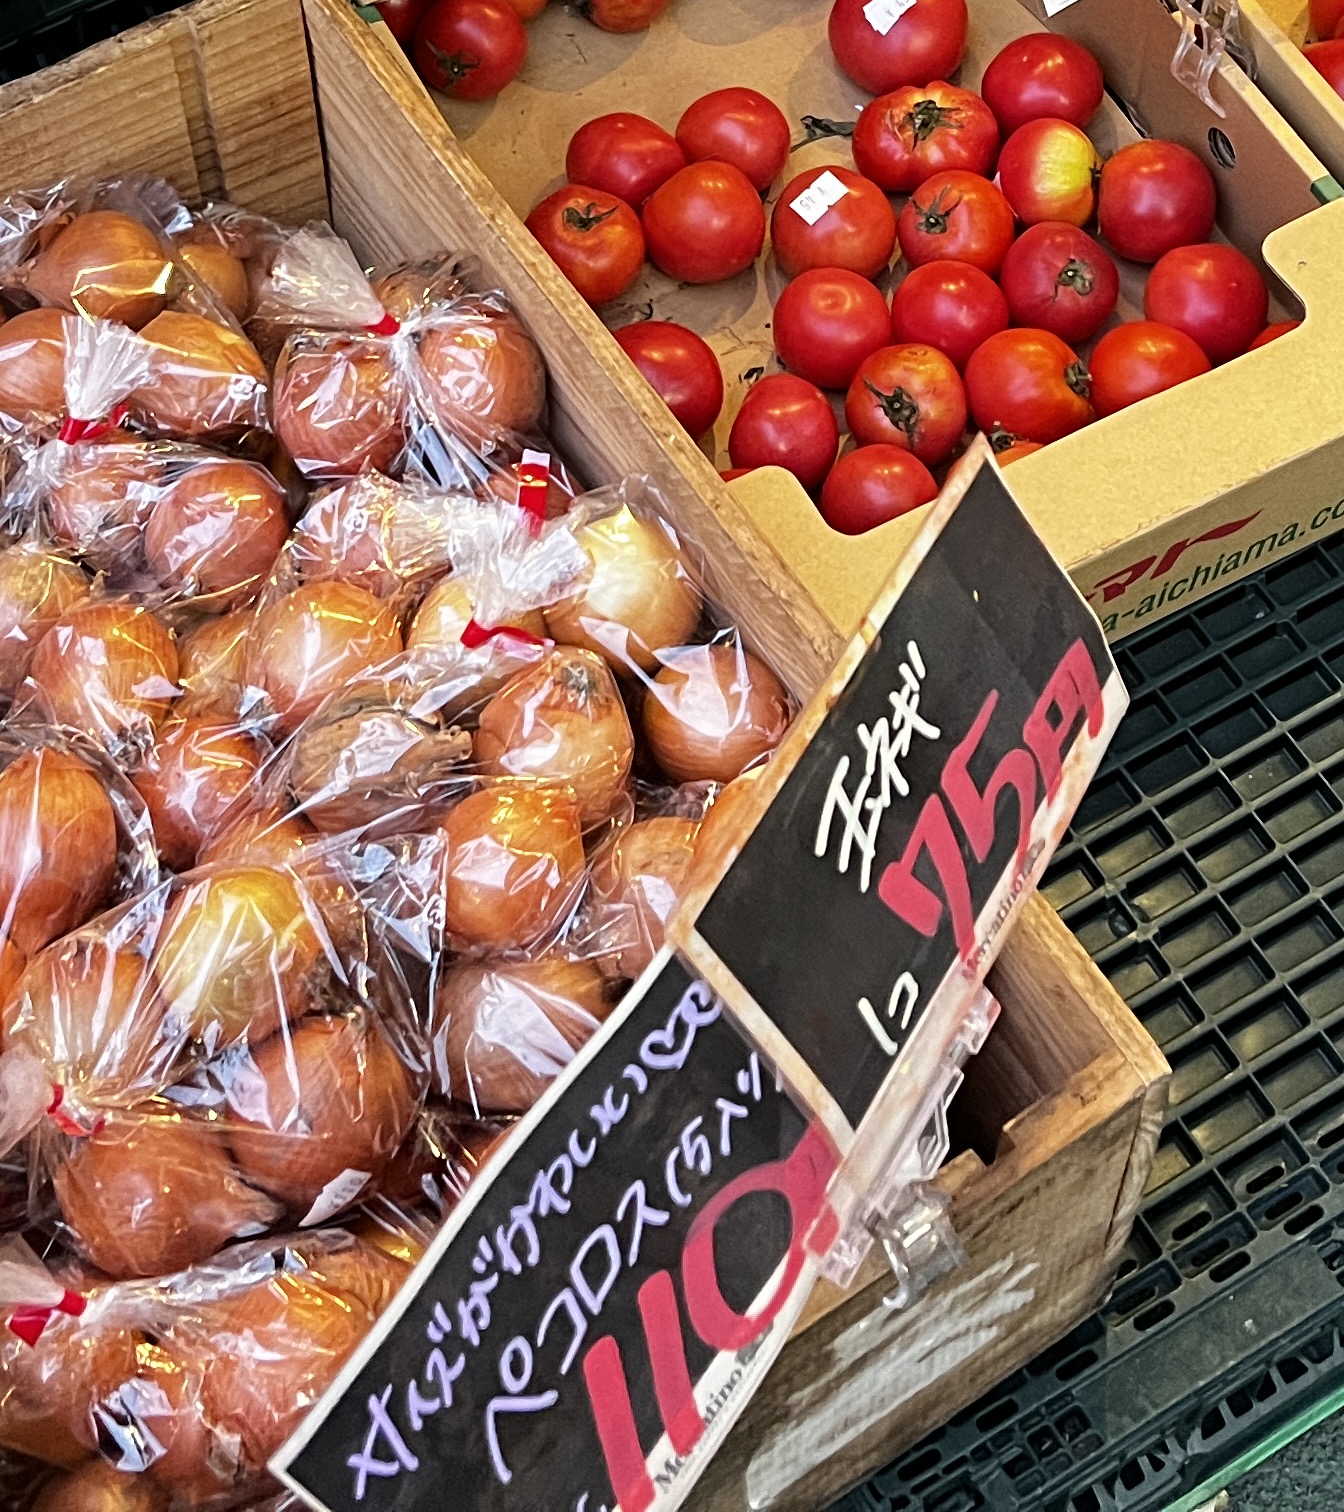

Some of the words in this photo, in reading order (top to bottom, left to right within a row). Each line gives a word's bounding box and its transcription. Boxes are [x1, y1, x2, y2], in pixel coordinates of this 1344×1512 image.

[813, 639, 942, 894] 玉ネギ
[878, 637, 1105, 963] 75円
[582, 1120, 841, 1512] 110
[654, 1368, 743, 1495] Metino
